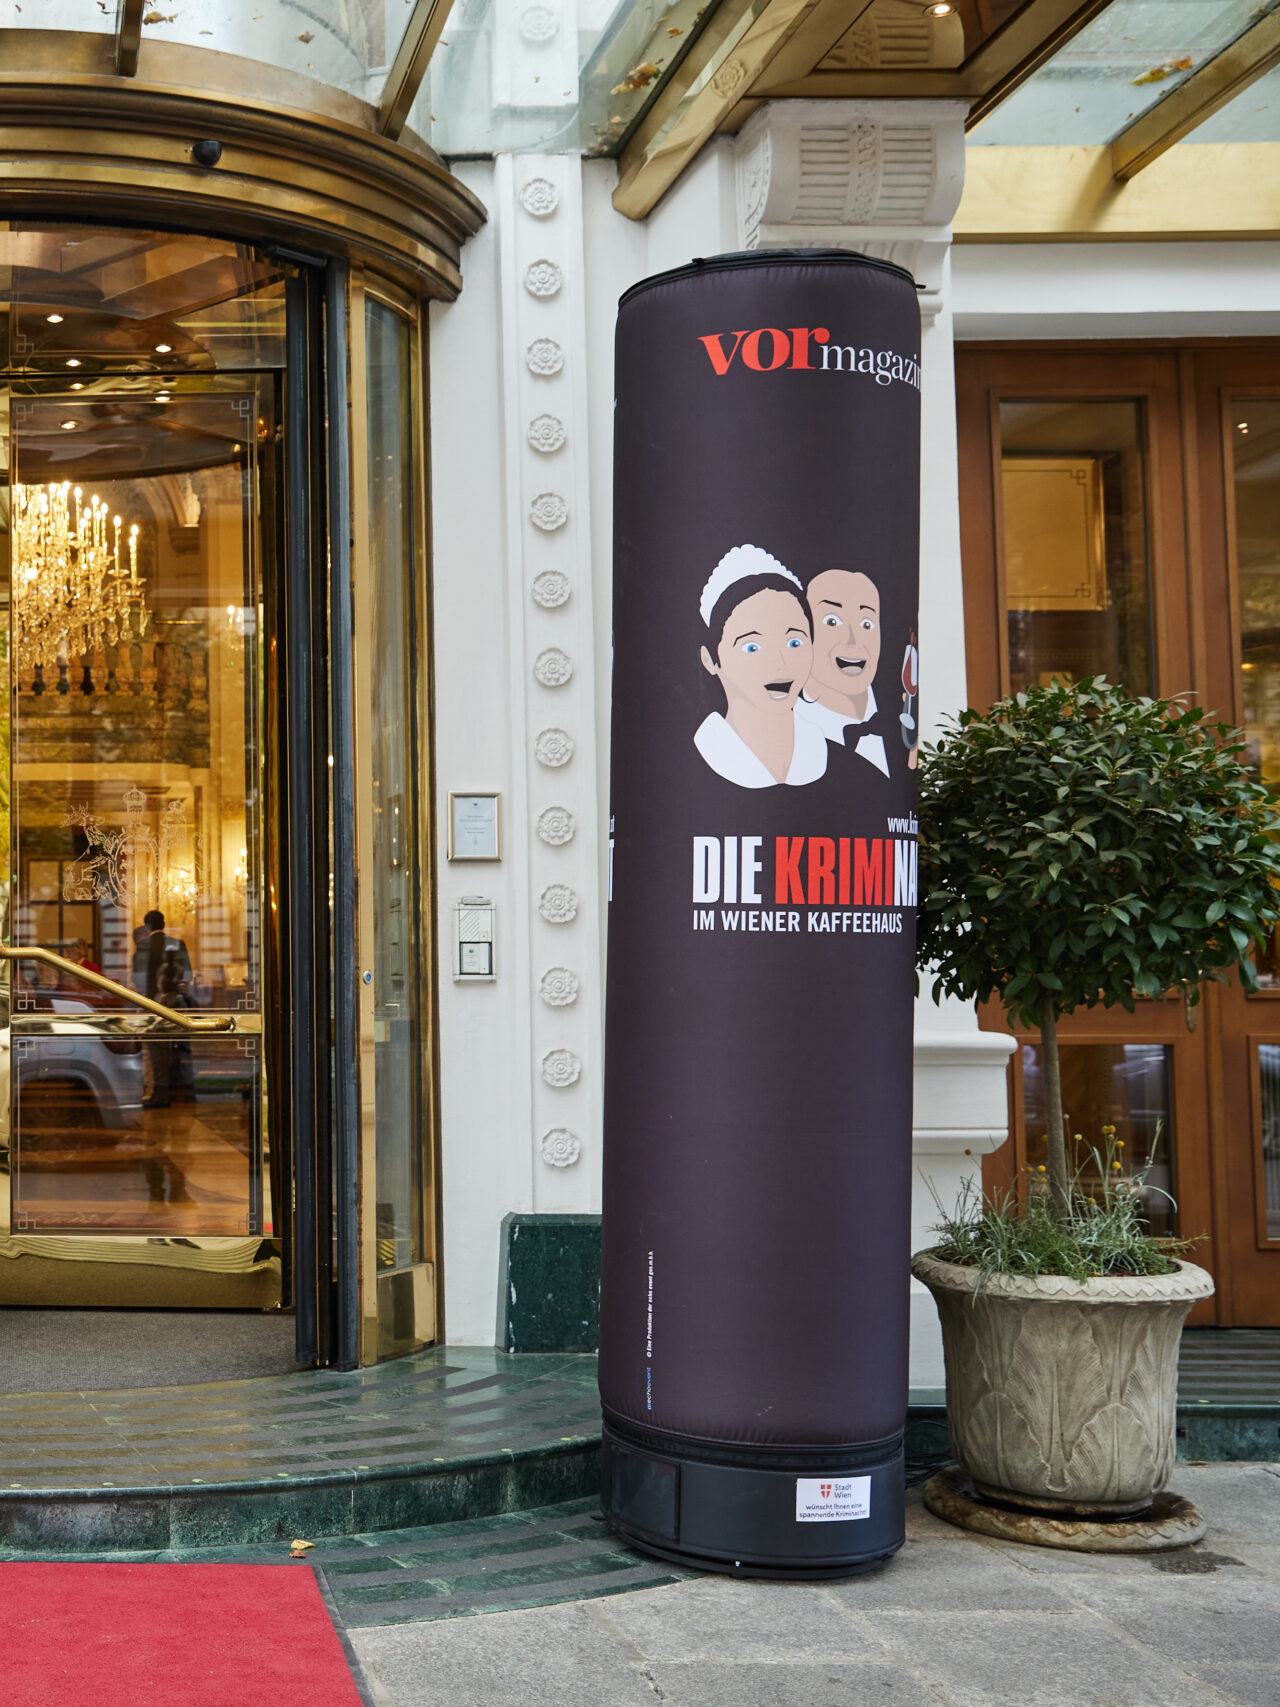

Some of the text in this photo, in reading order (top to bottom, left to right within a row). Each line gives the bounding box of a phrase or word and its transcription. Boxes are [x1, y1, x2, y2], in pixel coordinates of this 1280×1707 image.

[693, 836, 763, 904] DIE
[693, 910, 902, 933] IM WIENER KAFFEEHAUS
[834, 1491, 852, 1499] Wien
[799, 1511, 835, 1519] spannende
